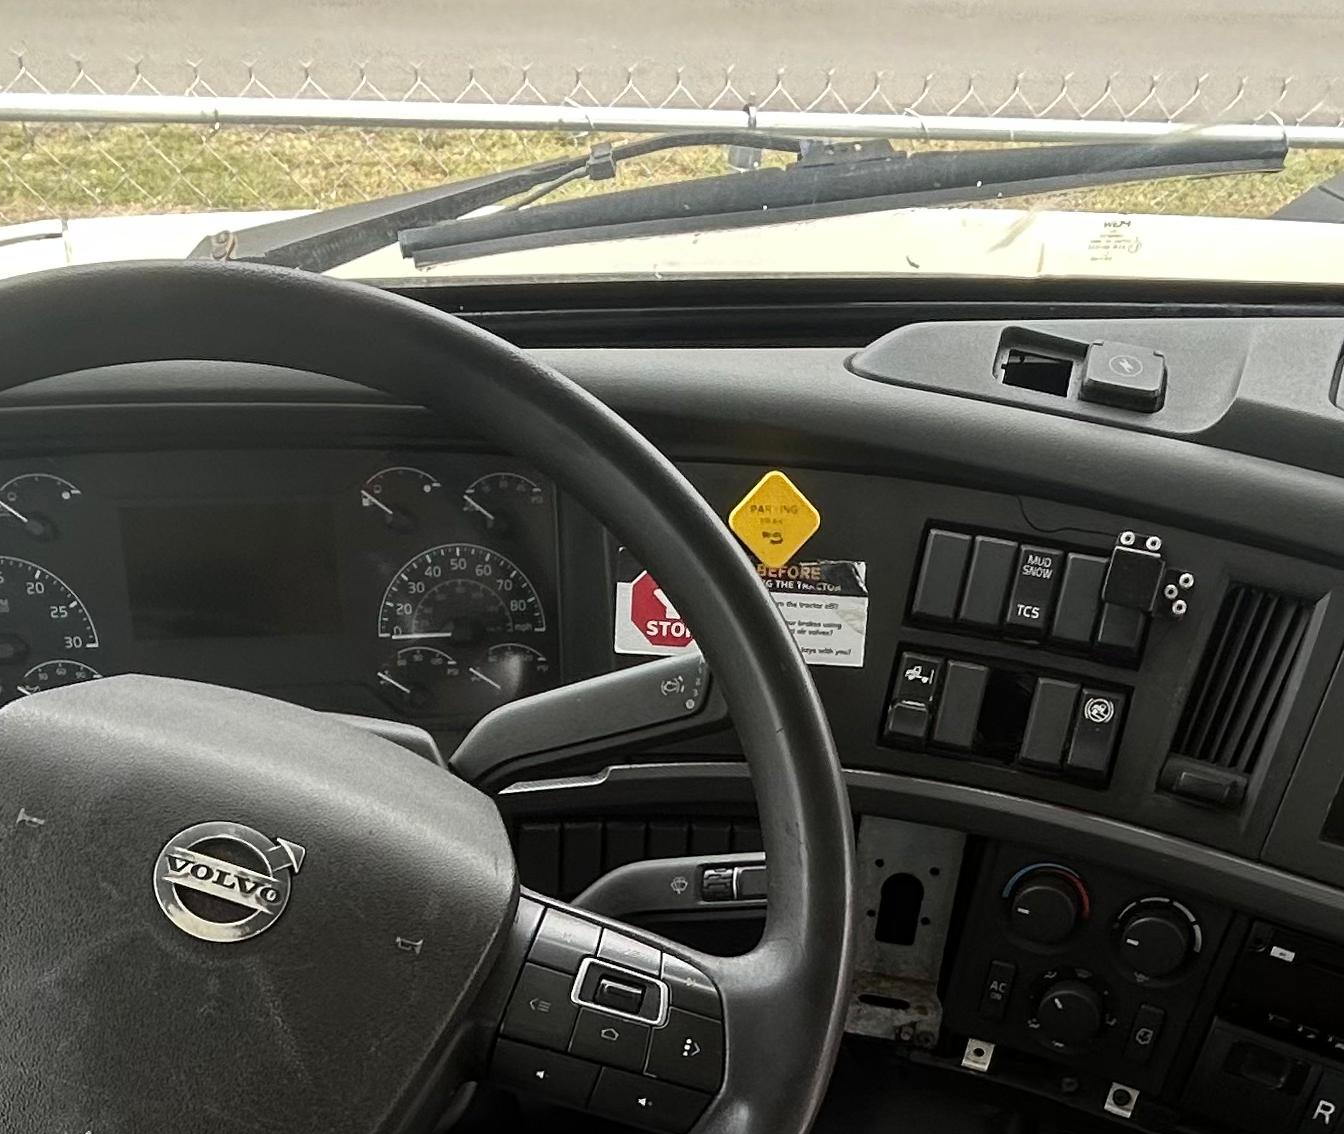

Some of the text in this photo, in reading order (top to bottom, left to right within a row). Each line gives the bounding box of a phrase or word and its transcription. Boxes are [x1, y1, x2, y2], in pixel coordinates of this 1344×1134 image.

[750, 504, 798, 514] PARING
[450, 558, 467, 570] 50
[1027, 554, 1052, 568] MUD
[424, 565, 442, 577] 40
[476, 565, 492, 576] 60
[757, 565, 821, 580] BEFORE
[1022, 565, 1053, 579] SNOW
[26, 582, 45, 595] 20
[408, 582, 425, 593] 30
[497, 579, 513, 591] 70
[776, 580, 794, 589] THE
[396, 603, 413, 615] 20
[510, 599, 527, 611] 80
[50, 606, 68, 618] 25
[1017, 604, 1040, 619] TCS
[798, 619, 821, 627] brakes
[64, 636, 82, 648] 30
[168, 855, 281, 903] VOLVO
[990, 980, 1006, 993] AC
[1312, 1100, 1336, 1125] R
